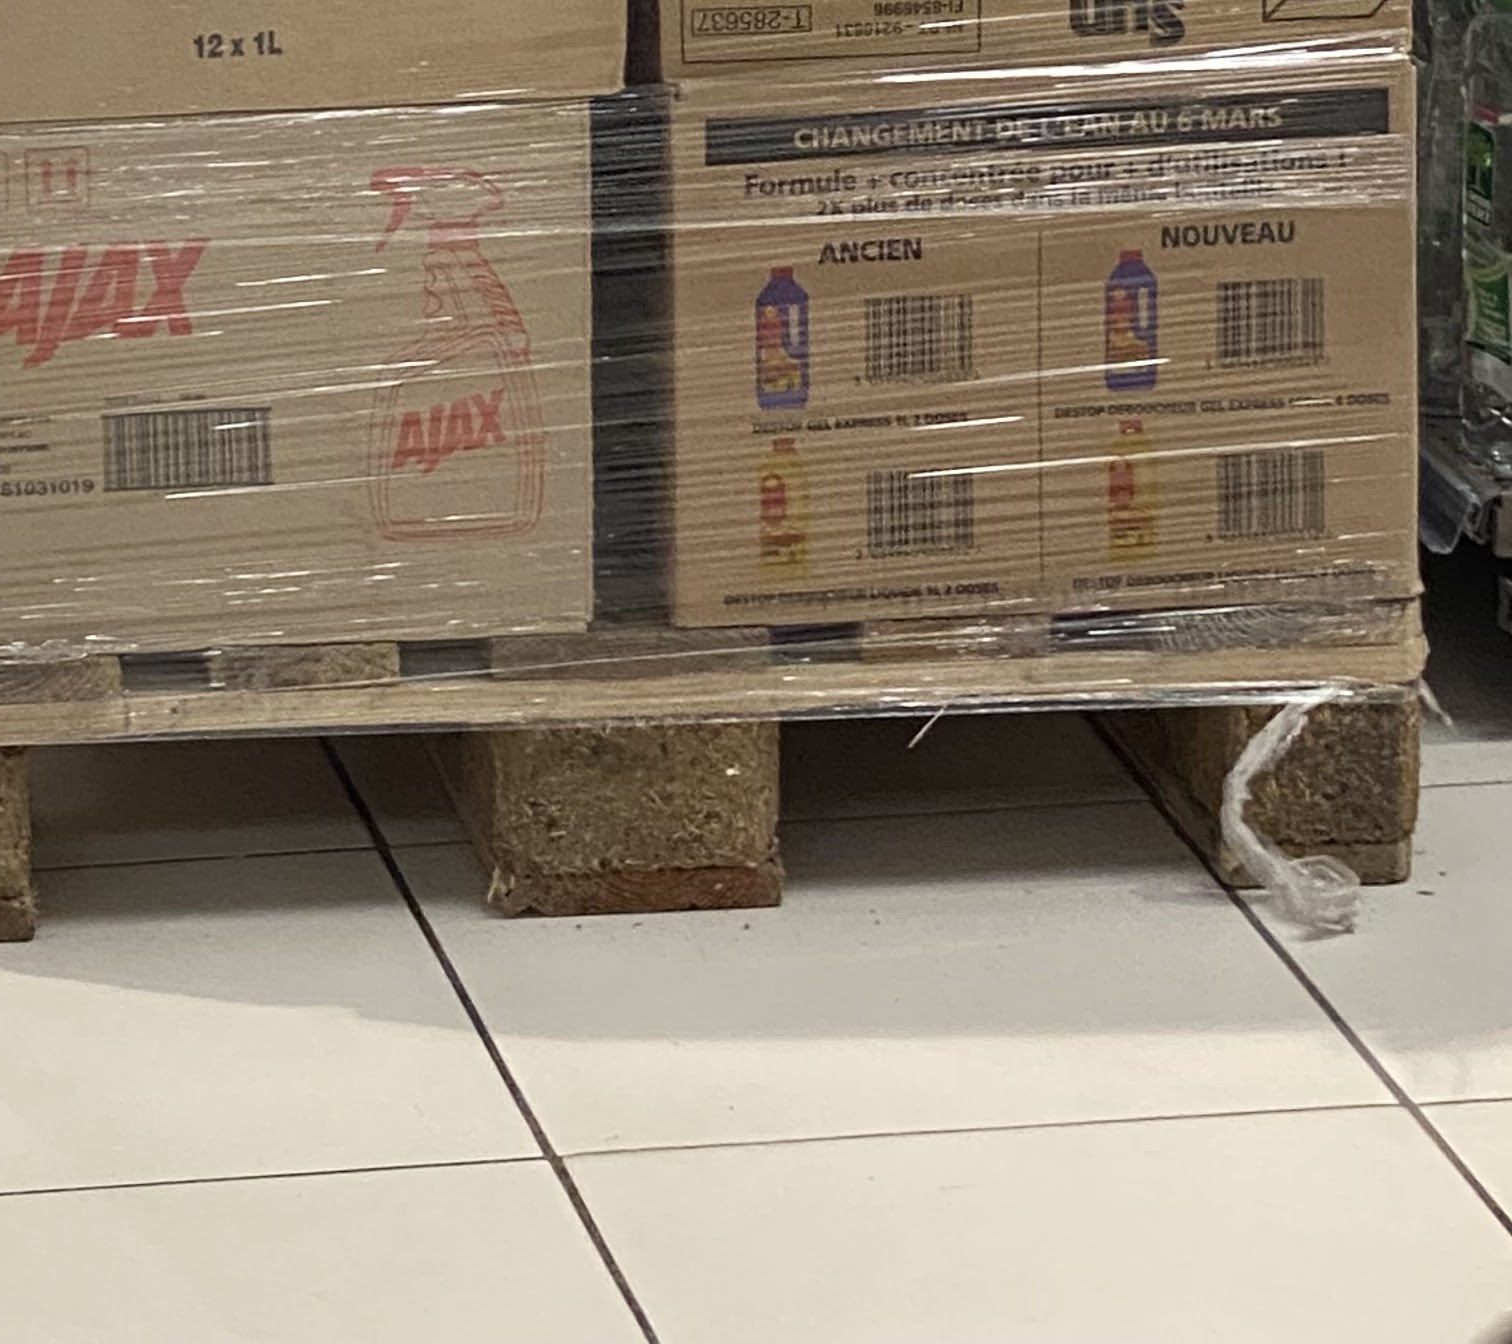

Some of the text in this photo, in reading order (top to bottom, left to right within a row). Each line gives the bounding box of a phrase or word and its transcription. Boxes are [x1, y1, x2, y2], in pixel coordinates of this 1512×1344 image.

[696, 9, 805, 31] T-285637
[194, 31, 283, 60] 12 x 1L
[794, 118, 985, 151] CHANGEMENT
[1129, 111, 1168, 137] AU
[1200, 104, 1285, 133] MARS
[744, 168, 858, 199] Formule
[1161, 219, 1296, 250] NOUVEAU
[818, 236, 923, 265] ANCIEN
[392, 387, 510, 475] AJAX
